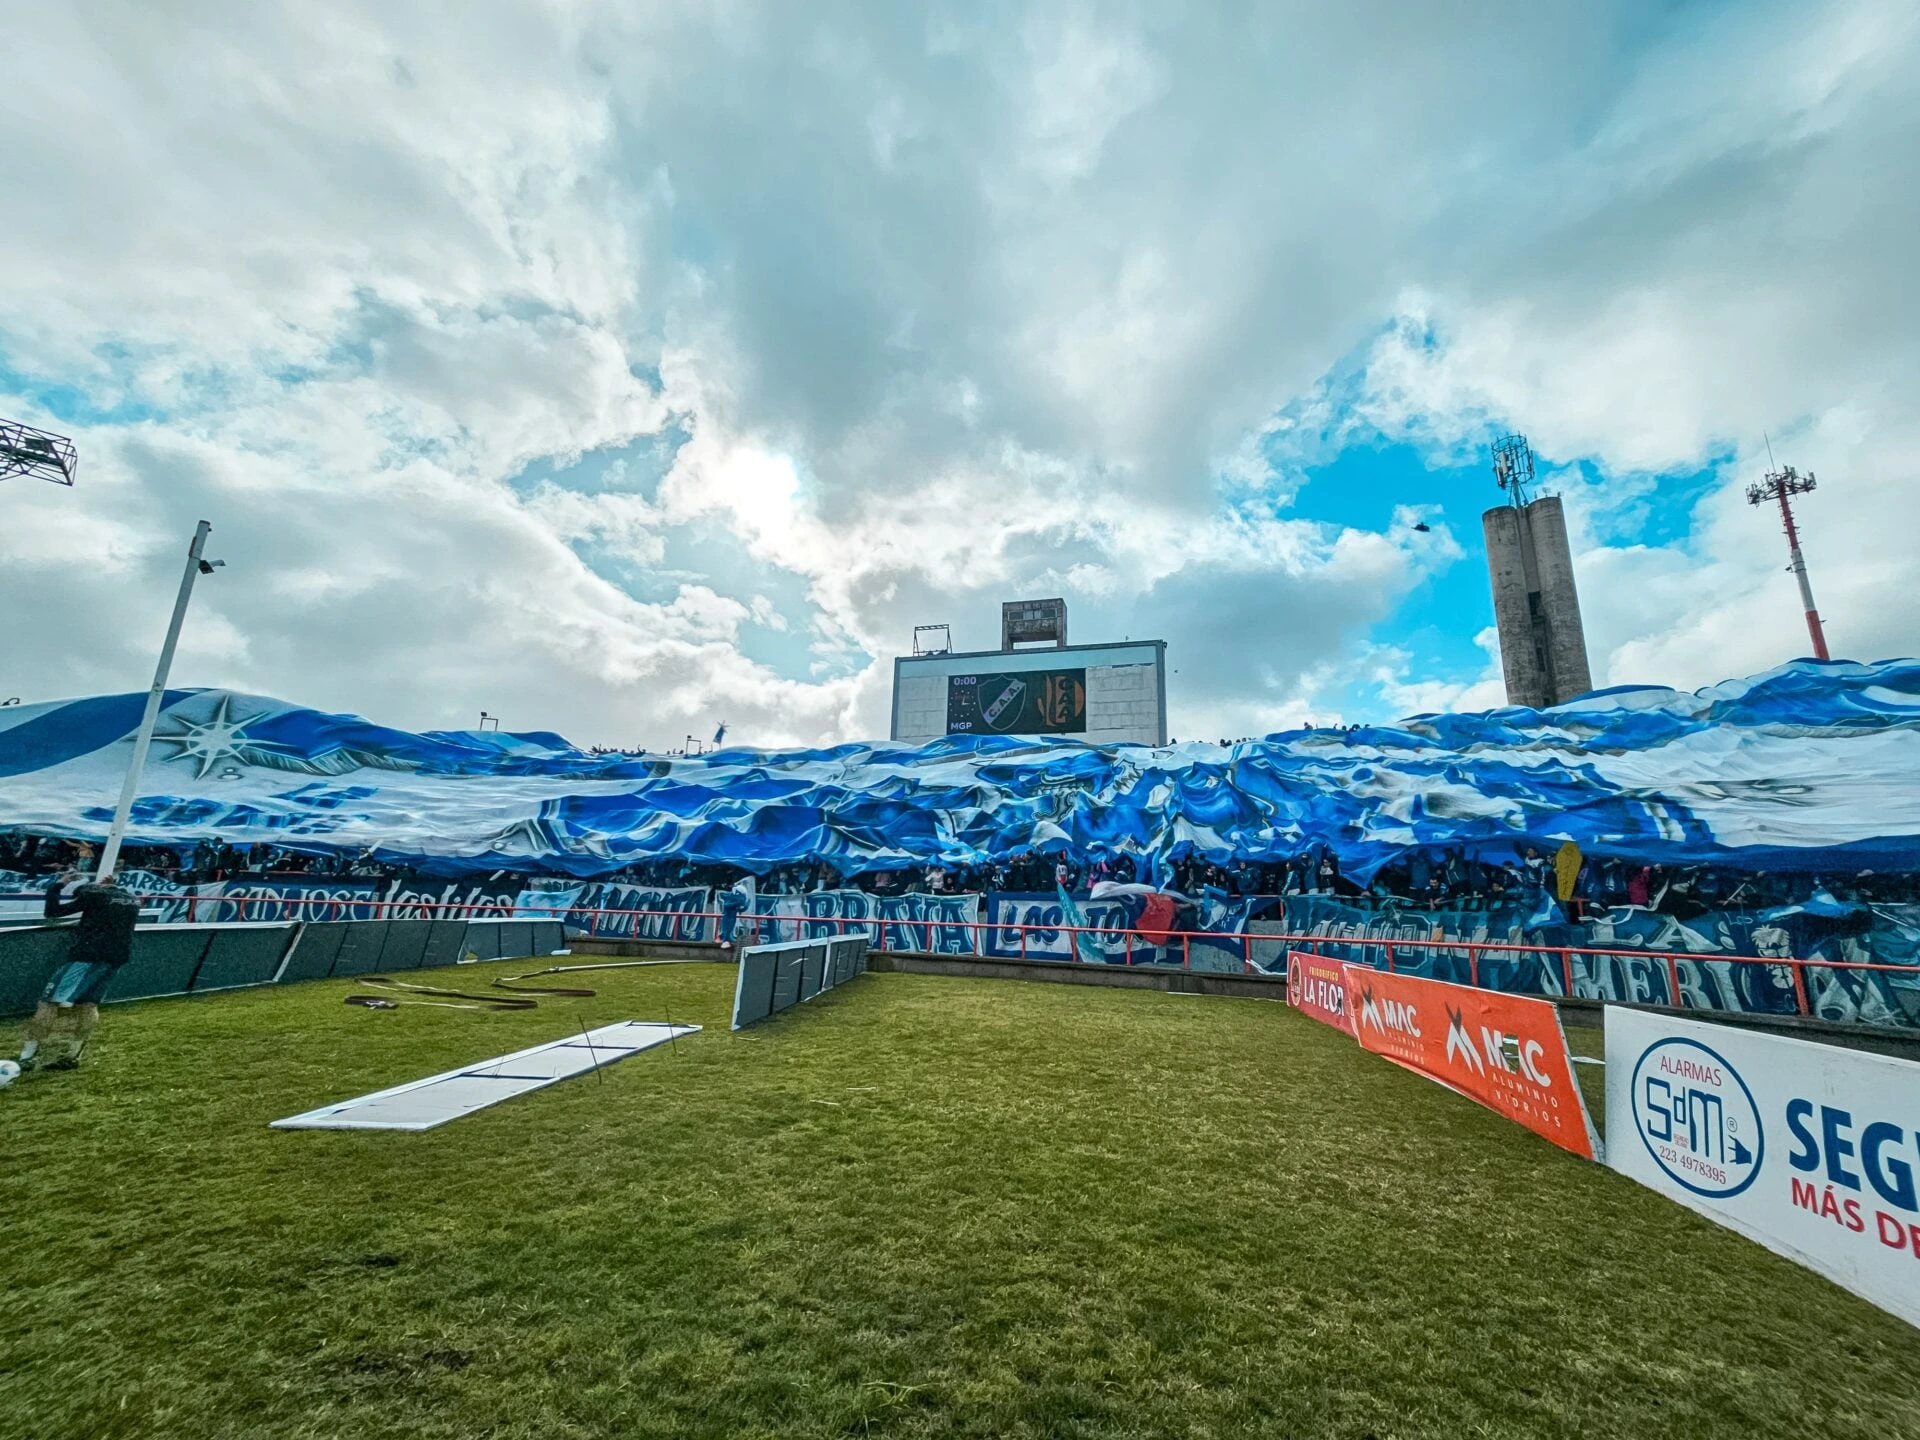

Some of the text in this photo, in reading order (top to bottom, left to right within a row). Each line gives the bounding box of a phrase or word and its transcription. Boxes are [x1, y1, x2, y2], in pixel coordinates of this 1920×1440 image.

[953, 676, 977, 686] 0:00
[950, 722, 973, 731] MGP
[117, 870, 179, 892] BARRIO
[224, 886, 288, 921] SAN
[1001, 904, 1063, 944] LAS
[1304, 977, 1316, 1005] LA
[1382, 997, 1421, 1038] MAC
[1660, 1056, 1722, 1087] ALARMAS
[1492, 1073, 1558, 1109] ALUMINIO
[1496, 1089, 1561, 1128] VIDRIOS
[1659, 1145, 1727, 1185] 223 4978395
[1785, 1098, 1920, 1213] SEG
[1791, 1176, 1866, 1234] MÁS
